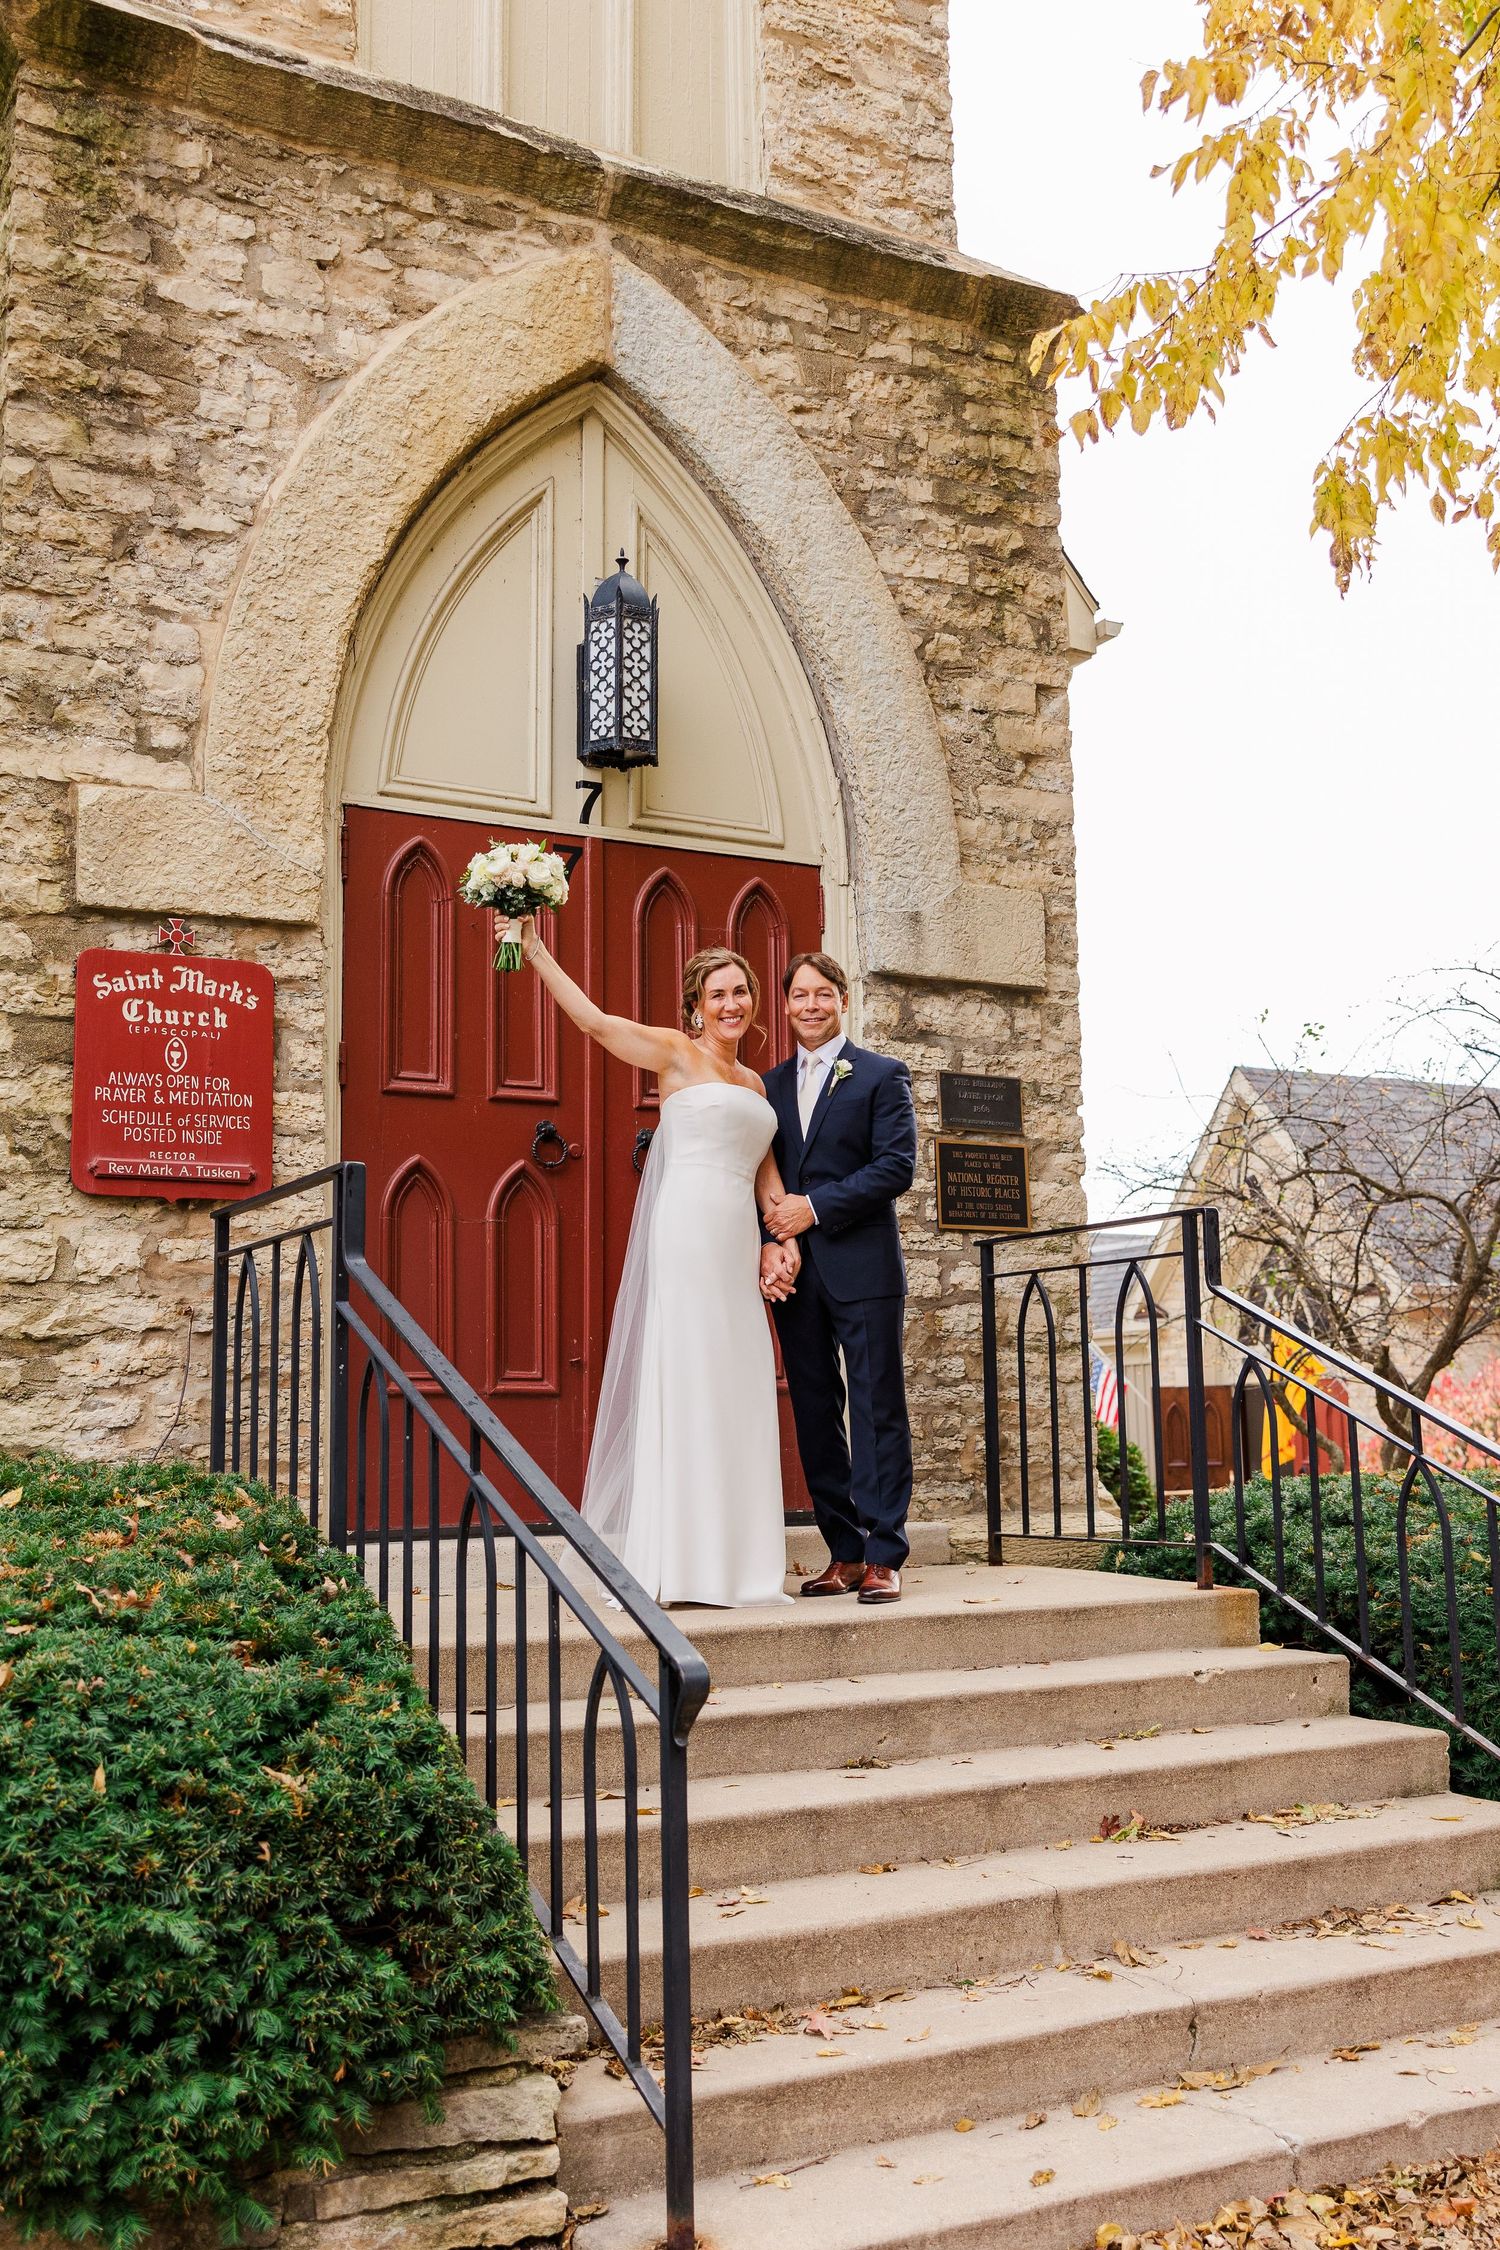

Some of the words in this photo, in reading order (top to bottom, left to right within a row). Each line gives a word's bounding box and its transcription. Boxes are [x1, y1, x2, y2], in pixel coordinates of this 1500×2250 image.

[576, 780, 602, 824] 7
[93, 968, 163, 999] Saint
[170, 965, 259, 1010] Mark's
[122, 998, 228, 1028] Church
[129, 1024, 221, 1040] (EPISCOPAL)
[108, 1071, 163, 1087] ALWAYS
[166, 1074, 199, 1089] OPEN
[204, 1077, 230, 1091] FOR
[95, 1086, 146, 1103] PRAYER
[153, 1090, 165, 1104] &
[169, 1091, 252, 1108] MEDITATION
[101, 1109, 172, 1126] SCHEDULE
[177, 1114, 191, 1126] of
[194, 1114, 250, 1130] SERVICES
[123, 1127, 176, 1143] POSTED
[182, 1130, 222, 1144] INSIDE
[150, 1151, 196, 1160] RECTOR
[965, 1152, 988, 1160] PROPERTY
[108, 1162, 133, 1174] Rev.
[138, 1163, 173, 1176] Mark
[179, 1166, 192, 1177] A.
[196, 1166, 240, 1179] Tusken
[947, 1172, 983, 1184] NATIONAL
[986, 1174, 1019, 1186] REGISTER
[947, 1185, 957, 1196] OF
[960, 1186, 992, 1198] HISTORIC
[994, 1188, 1020, 1199] PLACES
[948, 1210, 978, 1218] DEPARTMENT
[999, 1212, 1021, 1220] INTERIOR
[995, 1204, 1013, 1212] STATES
